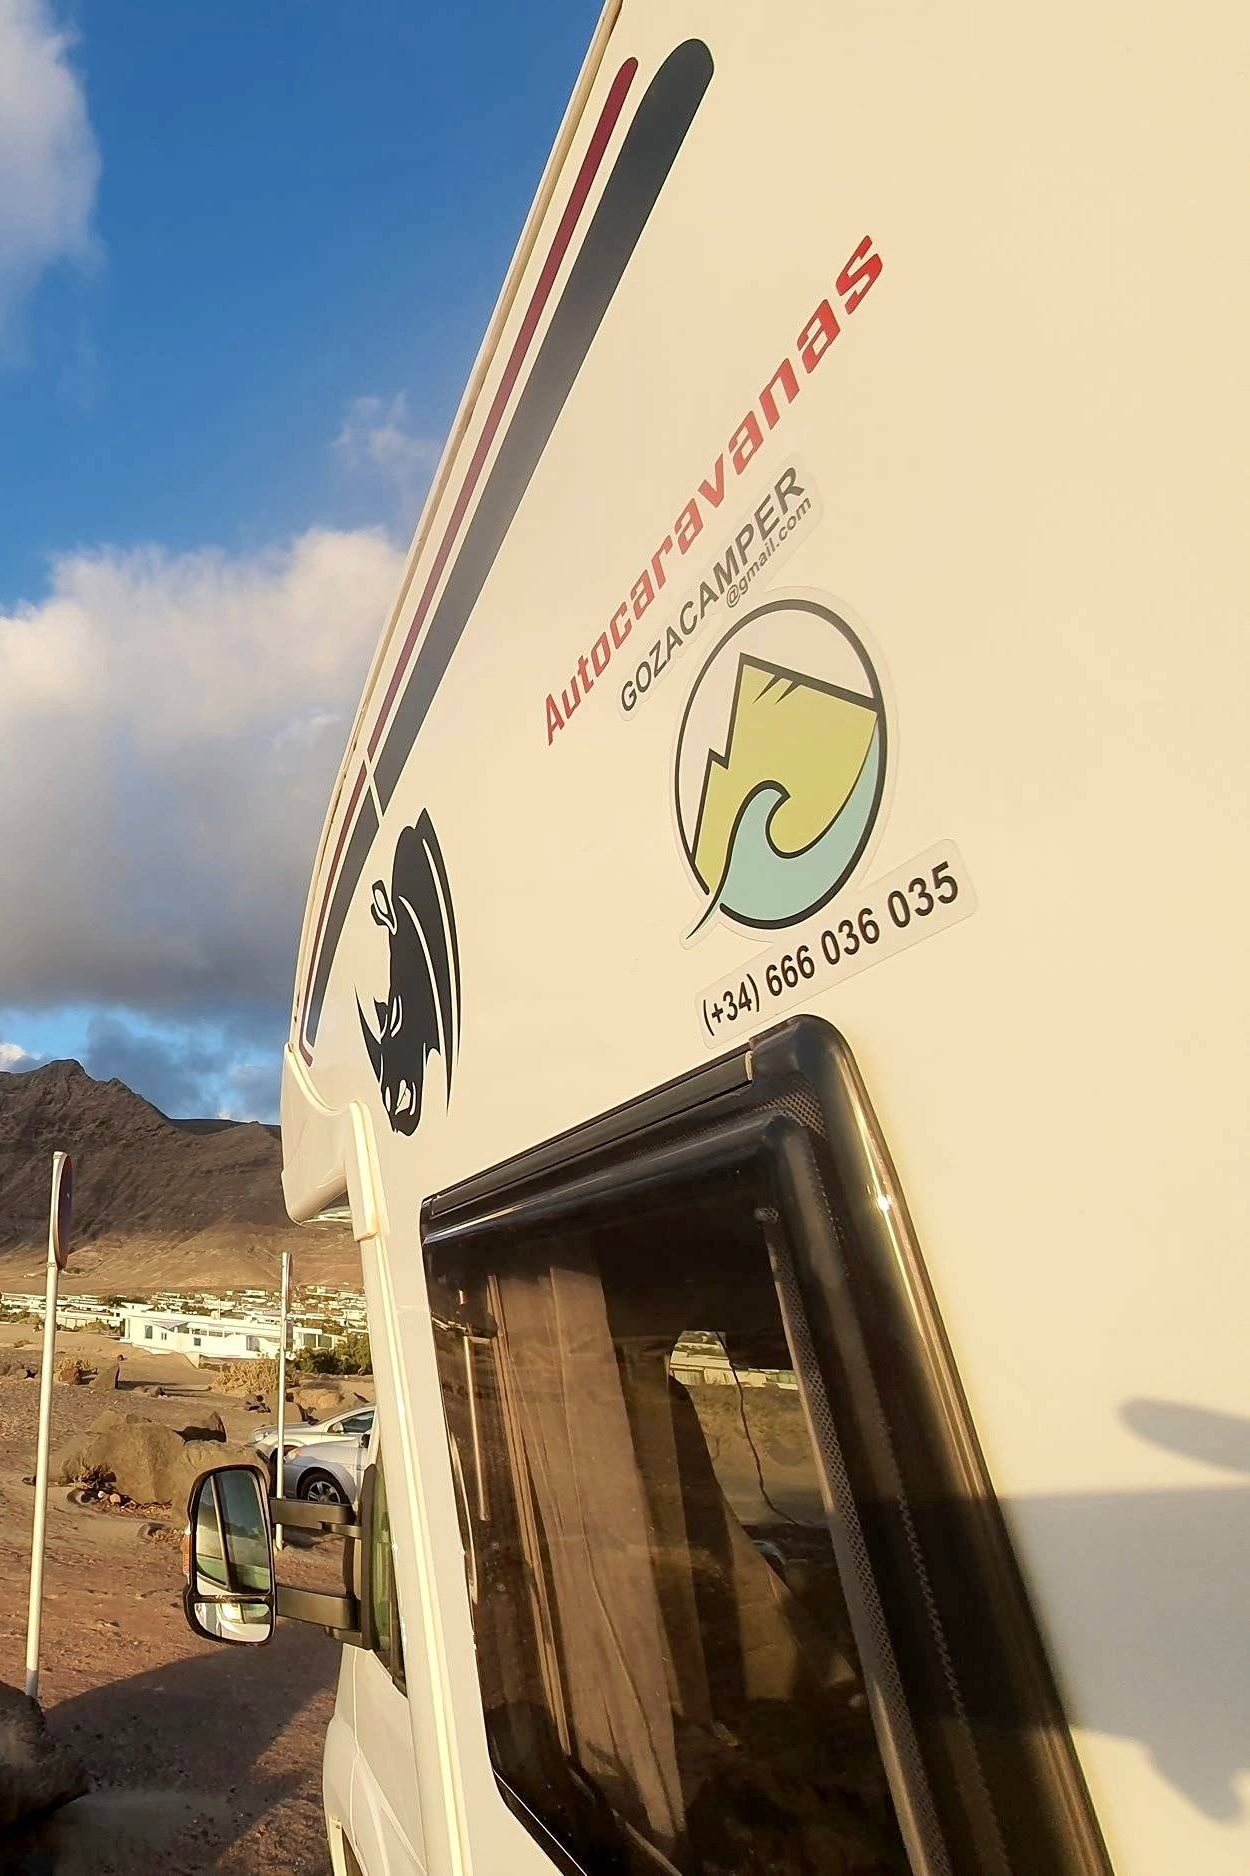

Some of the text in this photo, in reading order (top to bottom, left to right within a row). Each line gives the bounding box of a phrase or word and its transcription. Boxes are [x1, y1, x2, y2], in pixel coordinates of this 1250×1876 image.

[545, 235, 883, 746] Autocaravanas
[621, 467, 805, 711] GOZACAMPER
[726, 498, 812, 608] @gmail.com
[703, 861, 958, 1036] (+34) 666 036 035
